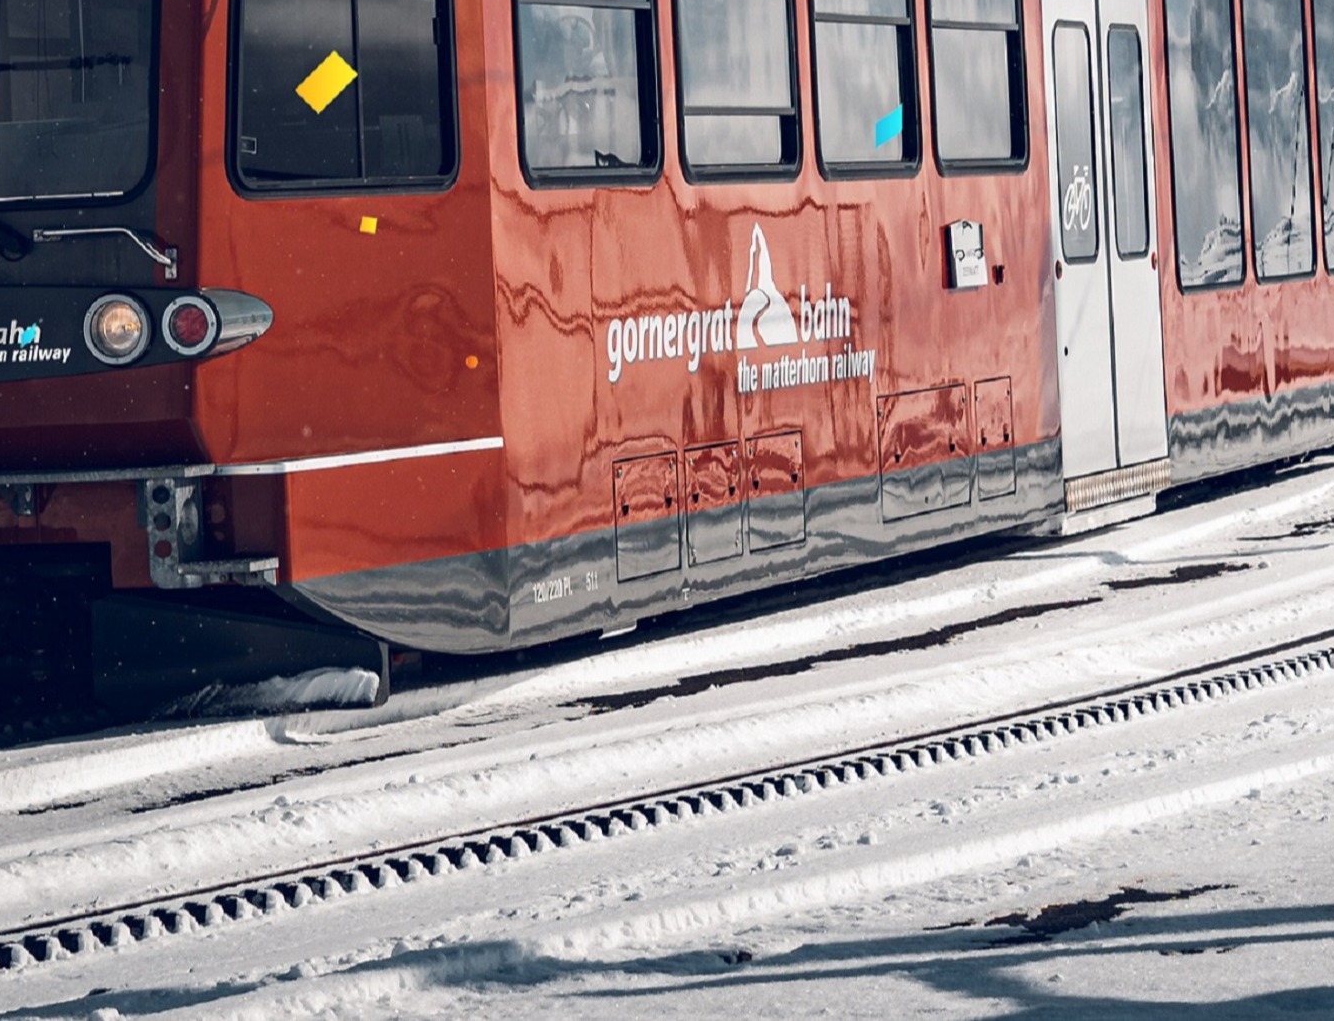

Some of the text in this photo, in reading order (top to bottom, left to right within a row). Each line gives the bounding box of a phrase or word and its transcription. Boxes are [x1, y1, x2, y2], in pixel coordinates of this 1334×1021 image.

[12, 345, 71, 364] railway
[606, 282, 851, 383] gornergrat bahn
[737, 342, 875, 393] the matterhorn railway
